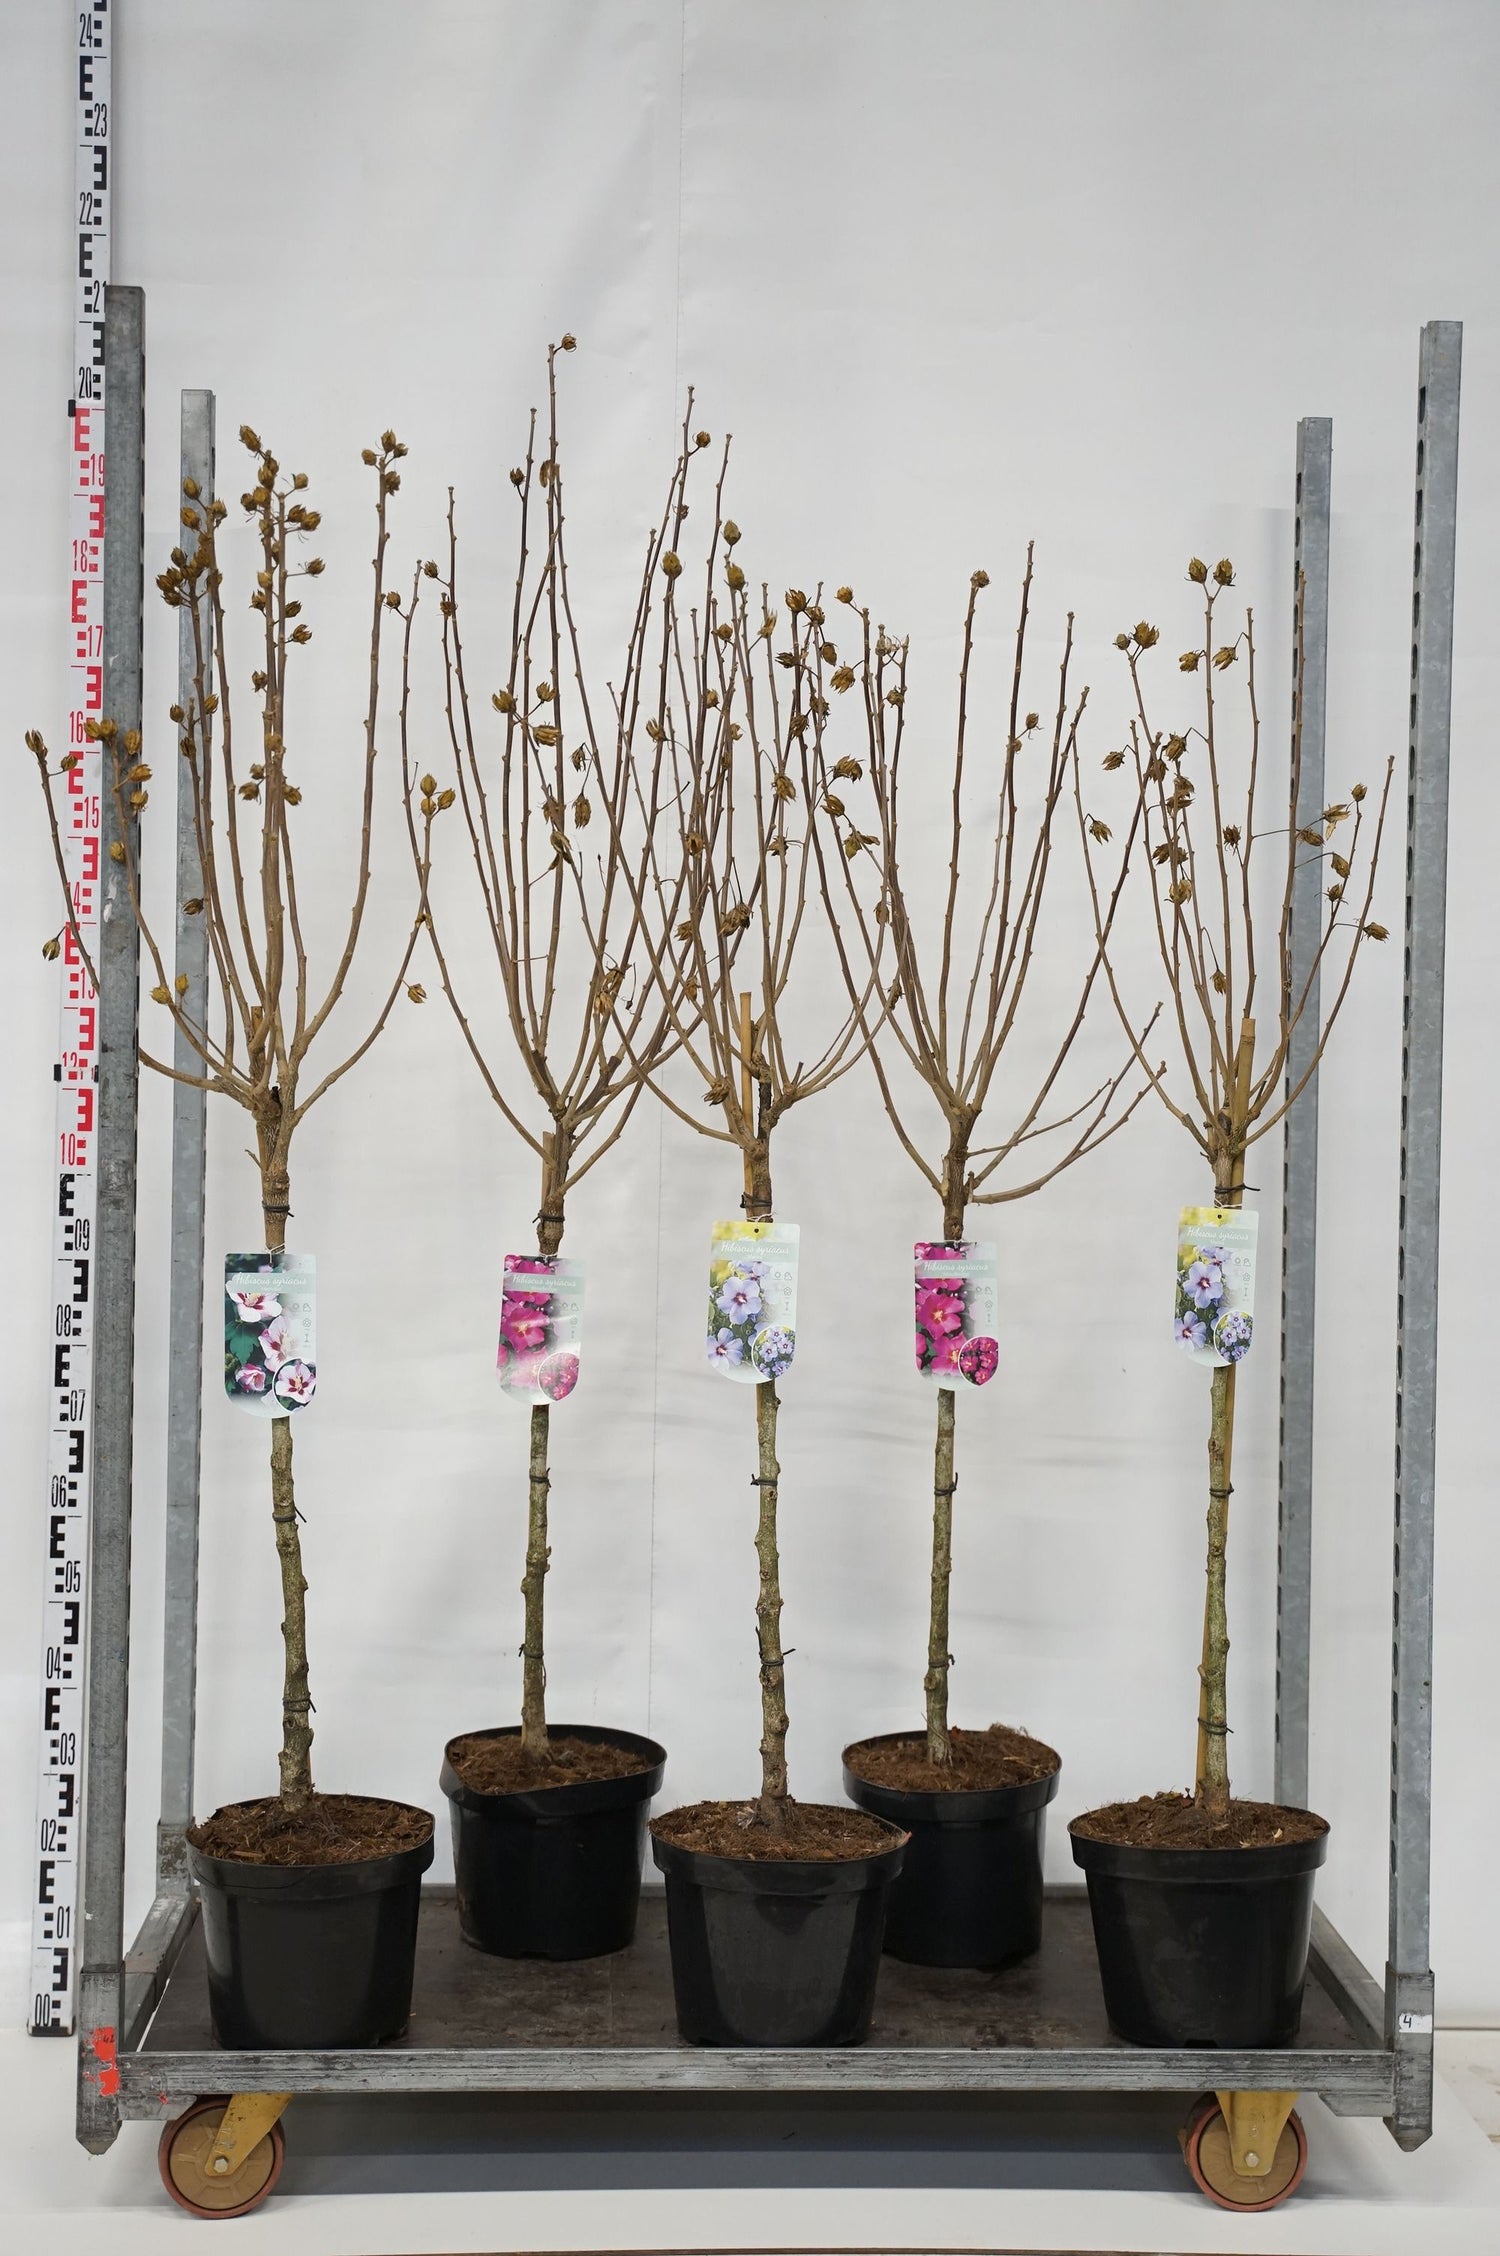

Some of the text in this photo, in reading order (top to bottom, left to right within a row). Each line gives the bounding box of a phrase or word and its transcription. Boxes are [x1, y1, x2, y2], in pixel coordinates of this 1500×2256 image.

[79, 13, 93, 48] 24
[94, 103, 107, 137] 23
[79, 192, 93, 225] 22
[78, 366, 92, 399] 20
[90, 453, 105, 487] 19
[72, 539, 88, 572] 18
[87, 625, 104, 657] 17
[69, 711, 83, 743] 16
[84, 796, 99, 829] 15
[67, 882, 80, 914] 4
[60, 1133, 76, 1166] 10
[74, 1218, 90, 1251] 09
[56, 1304, 71, 1337] 08
[70, 1389, 86, 1421] 07
[51, 1475, 67, 1508] 06
[65, 1560, 81, 1593] 05
[46, 1646, 61, 1679] 04
[60, 1732, 76, 1765] 03
[40, 1818, 57, 1851] 02
[56, 1905, 70, 1939] 01
[34, 1993, 50, 2027] 00
[1403, 2015, 1412, 2029] 4
